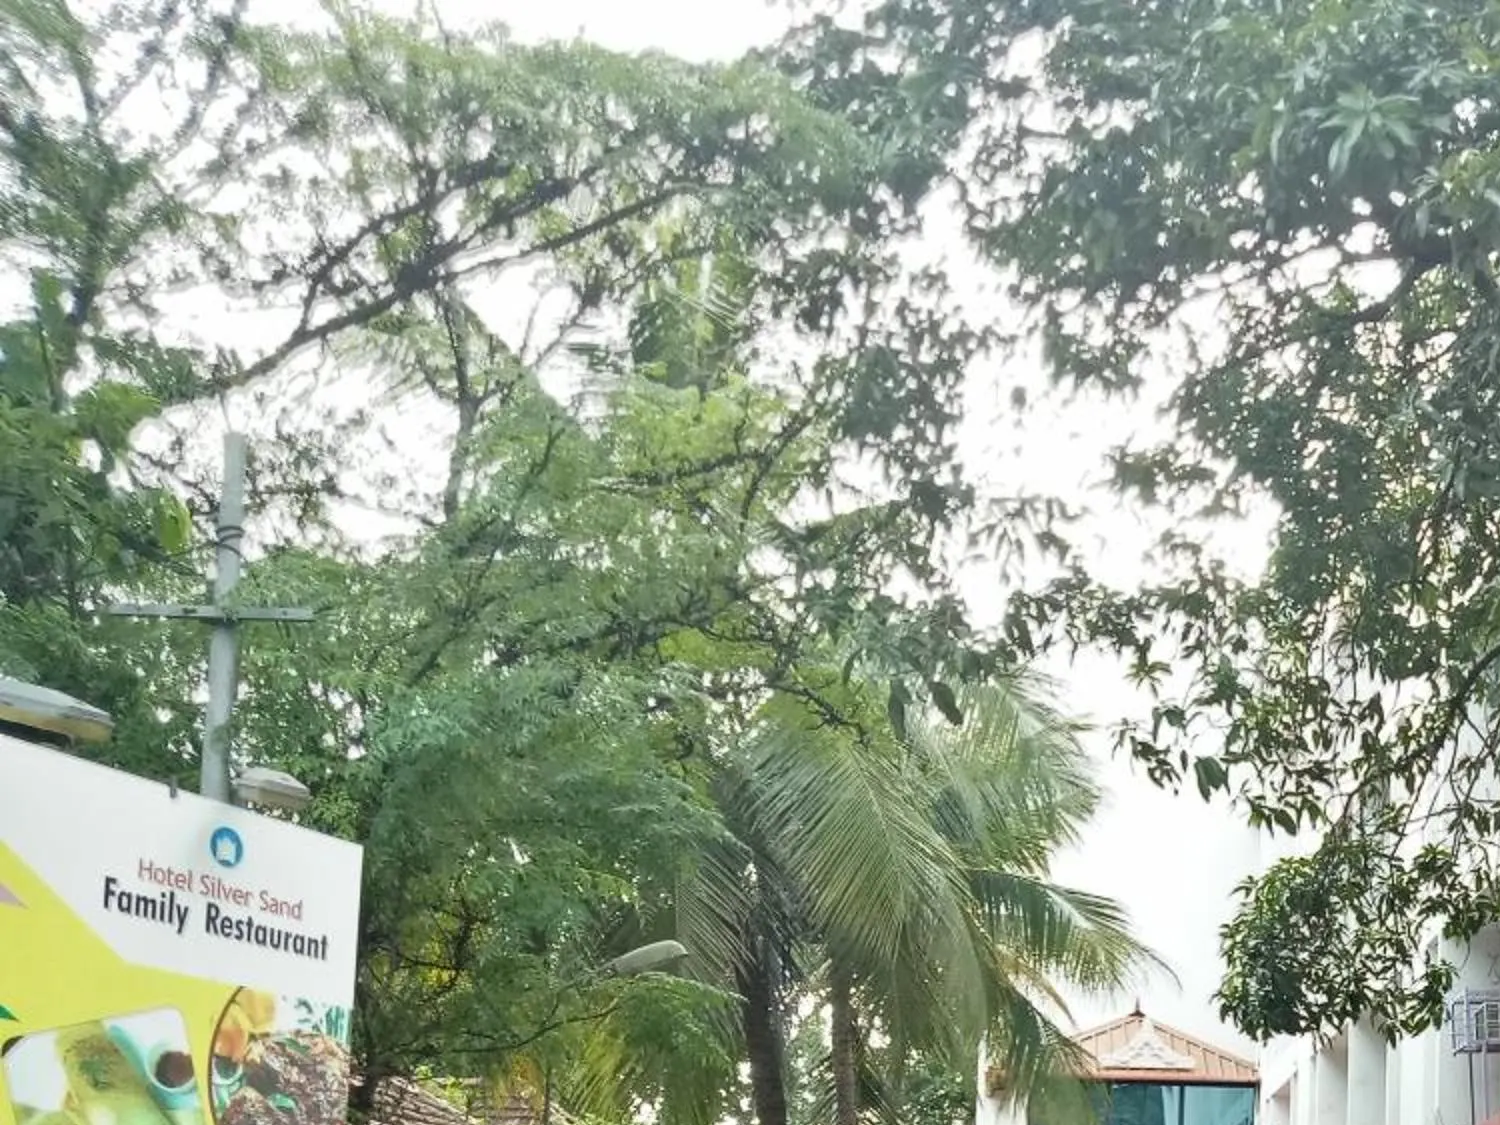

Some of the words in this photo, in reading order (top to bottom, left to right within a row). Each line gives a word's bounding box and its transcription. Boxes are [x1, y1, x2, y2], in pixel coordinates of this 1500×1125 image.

[103, 876, 189, 935] Family
[205, 902, 329, 961] Restaurant
[138, 858, 193, 892] Hotel
[199, 874, 254, 907] Silver
[259, 890, 304, 921] Sand
